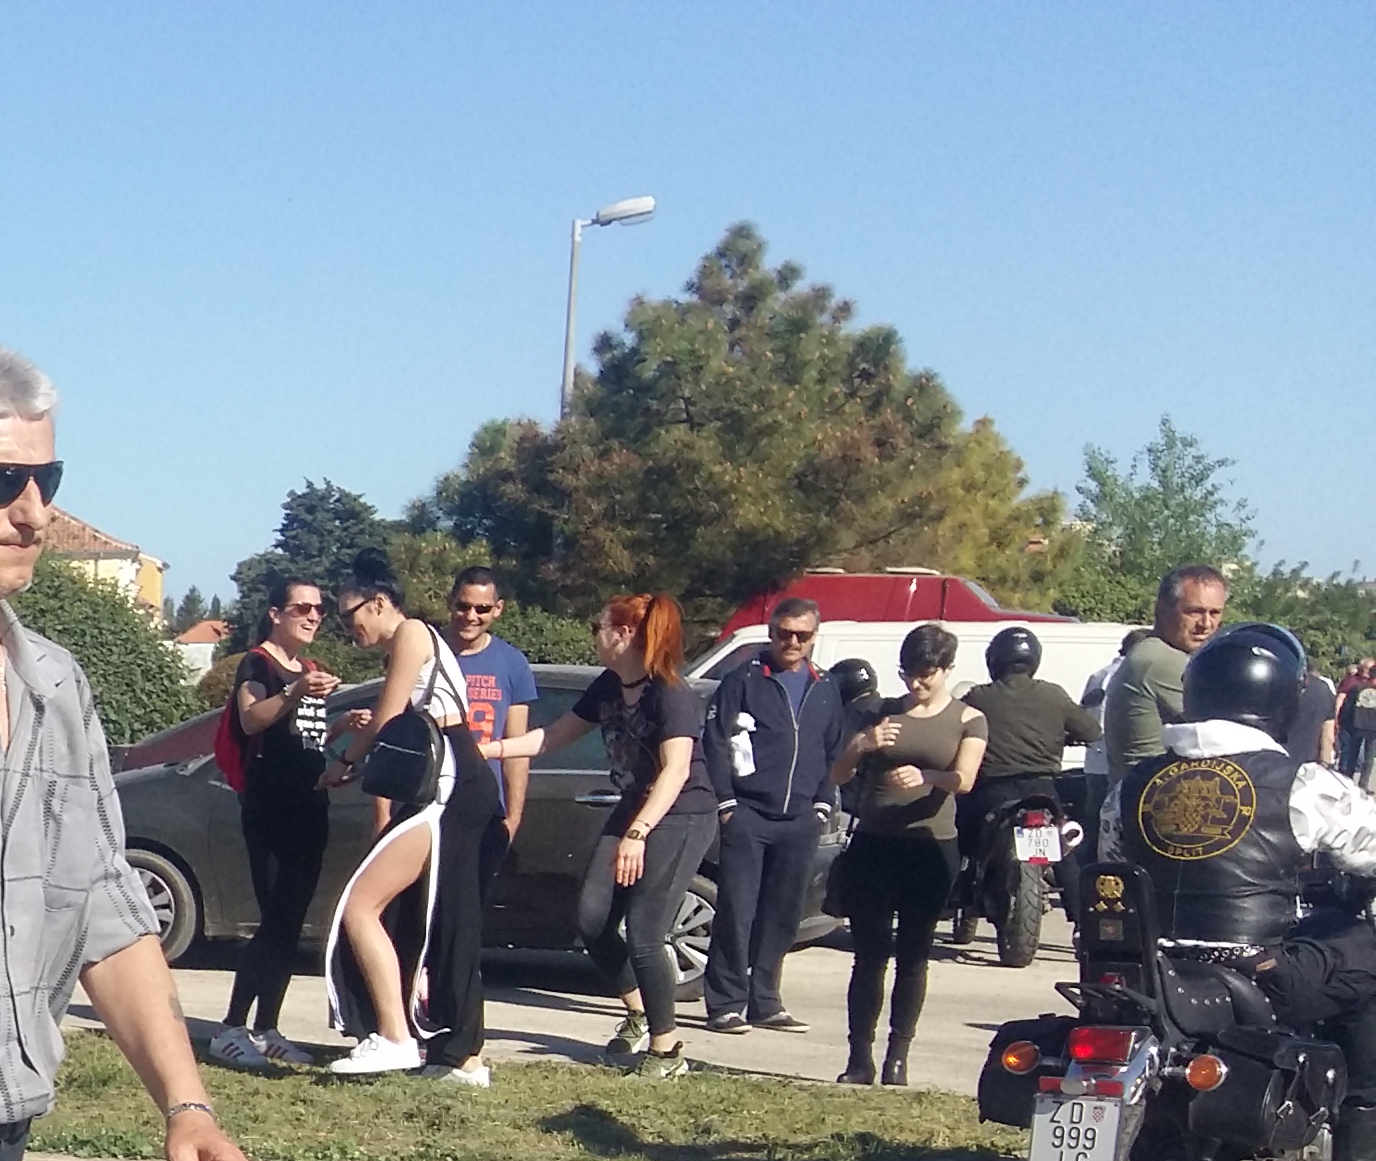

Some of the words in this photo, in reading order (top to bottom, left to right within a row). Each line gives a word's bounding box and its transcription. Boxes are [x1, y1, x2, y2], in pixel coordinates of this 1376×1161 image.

[465, 674, 496, 688] PITCH
[468, 687, 502, 701] SERIES
[1168, 846, 1203, 857] SPLIT
[1051, 1126, 1098, 1151] 999
